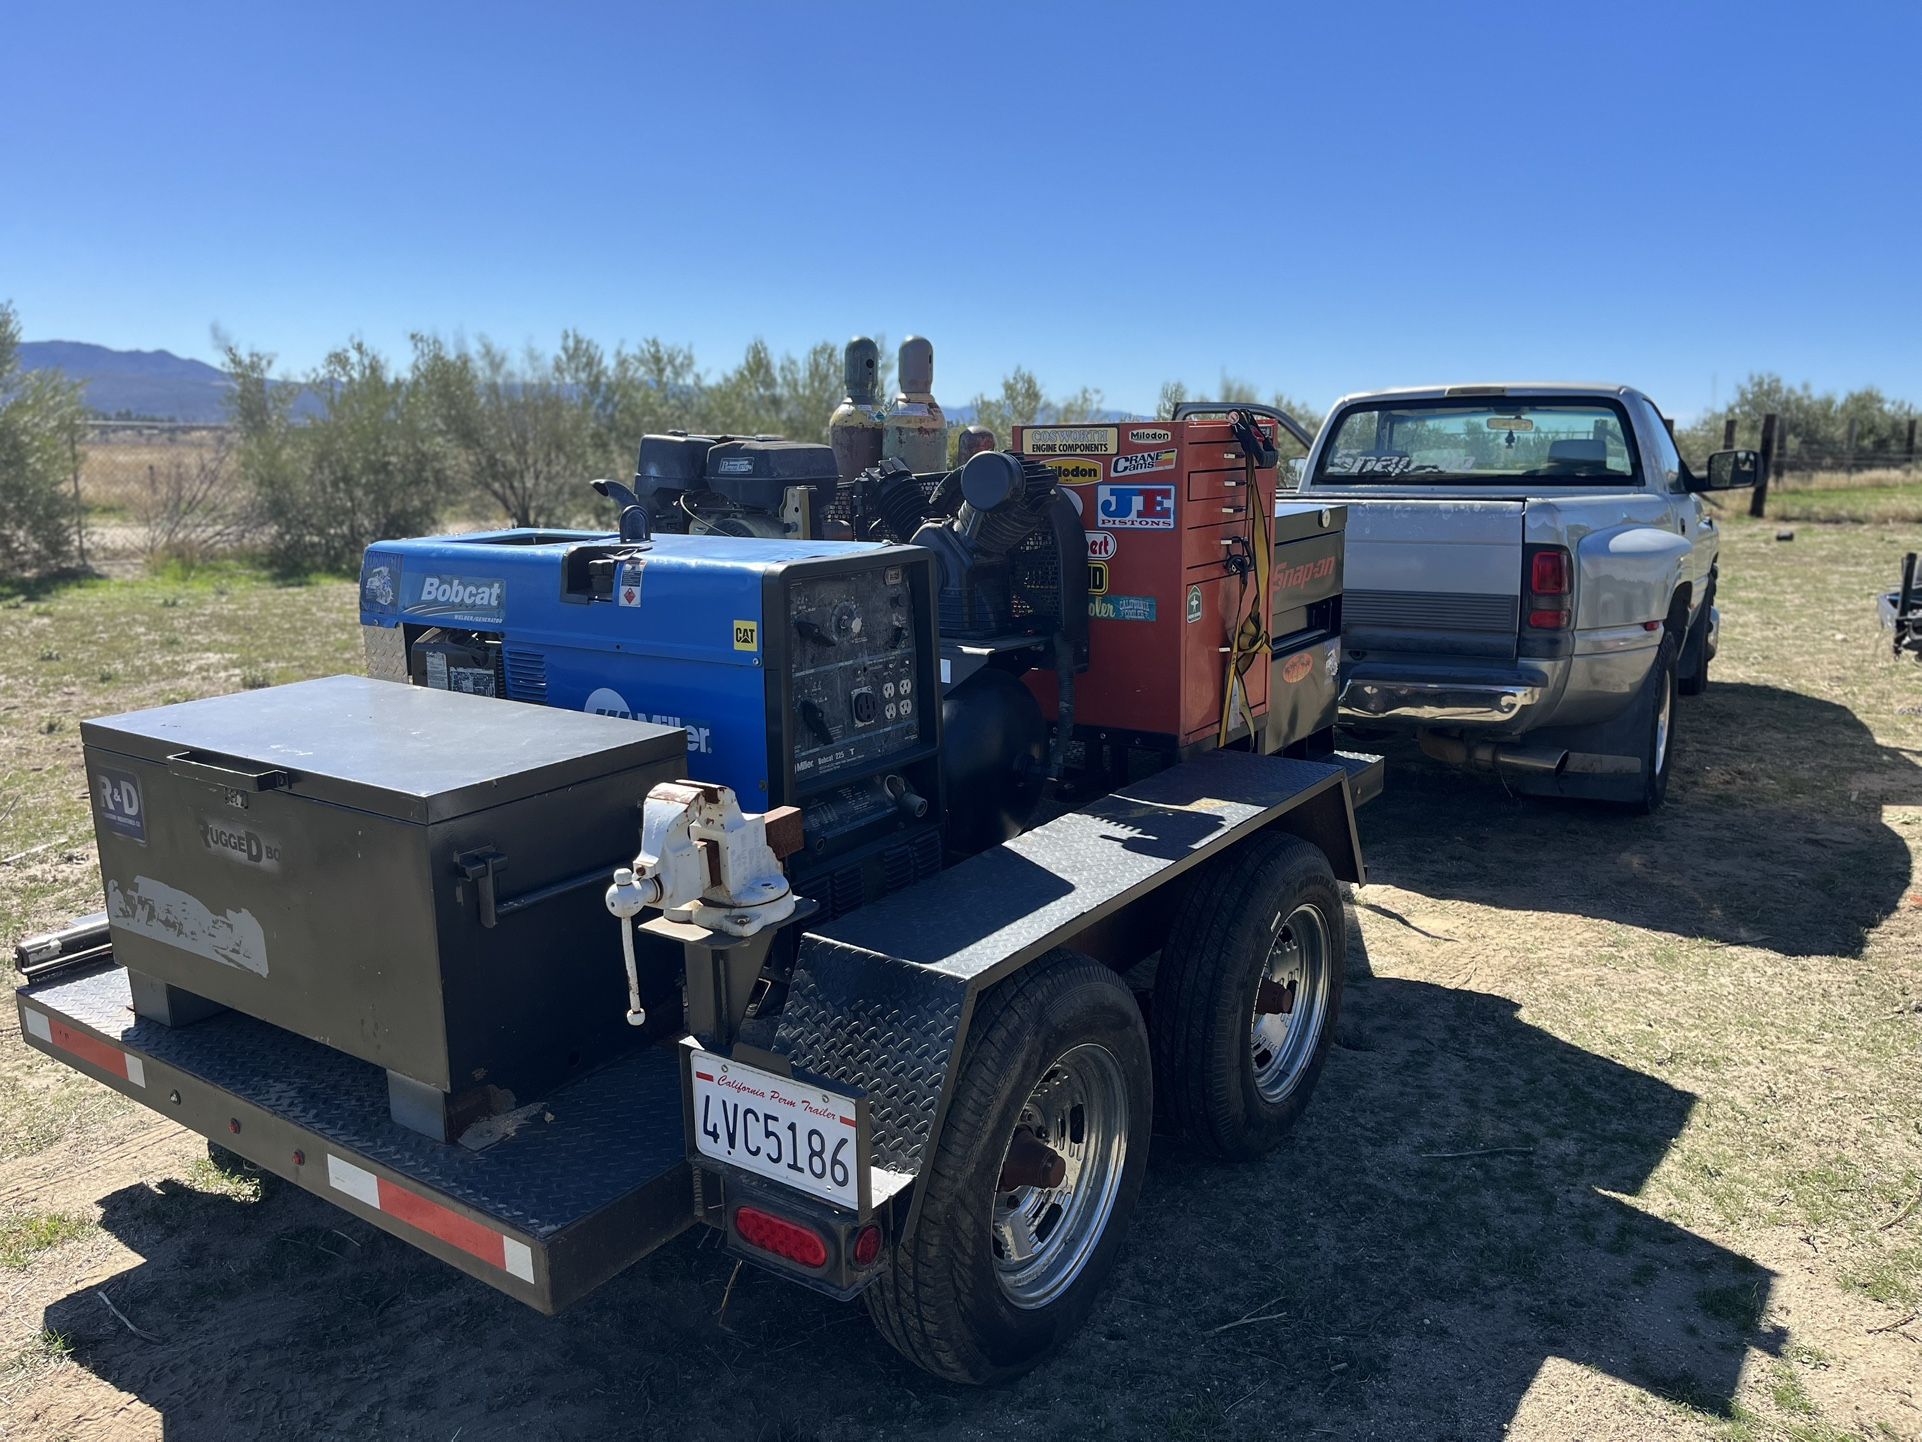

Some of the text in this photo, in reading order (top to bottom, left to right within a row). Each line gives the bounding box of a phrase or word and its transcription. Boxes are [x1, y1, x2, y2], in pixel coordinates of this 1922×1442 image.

[1032, 430, 1109, 443] COSWORTH
[1130, 431, 1169, 440] Milodon
[1032, 443, 1108, 453] ENGINE COMPONENTS
[1055, 465, 1098, 478] lodon
[1101, 488, 1172, 519] JE
[1101, 519, 1171, 527] PISTONS
[1272, 555, 1336, 592] Snap-on
[421, 577, 501, 606] Bobcat
[735, 627, 755, 643] CAT
[835, 751, 845, 760] 225
[97, 775, 140, 816] R&D
[717, 1074, 836, 1120] California Perm Trailer
[703, 1095, 849, 1187] 4VC5186
